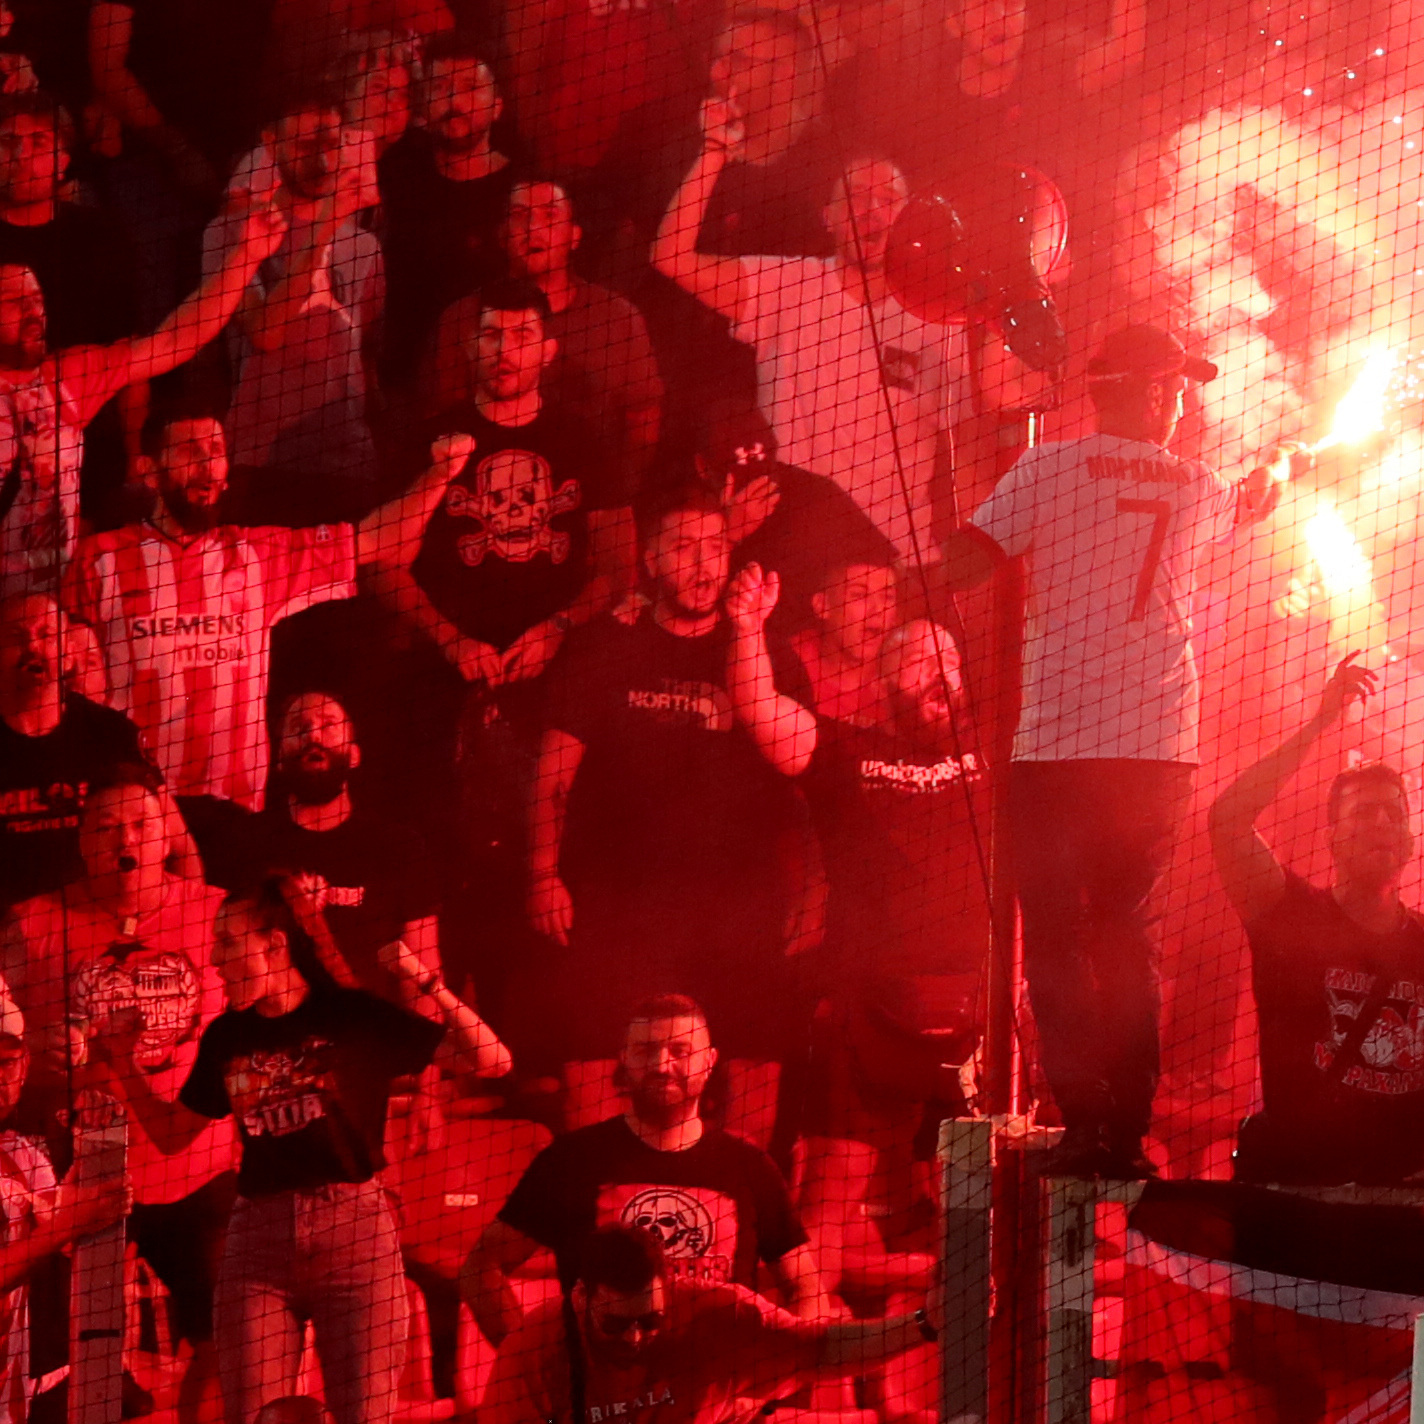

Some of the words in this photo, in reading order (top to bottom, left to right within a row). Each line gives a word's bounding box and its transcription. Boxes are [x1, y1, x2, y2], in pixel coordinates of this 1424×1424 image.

[1116, 497, 1171, 622] 7
[132, 615, 244, 638] SIEMENS
[628, 690, 698, 712] NORTH
[585, 1387, 675, 1423] RIKALA
